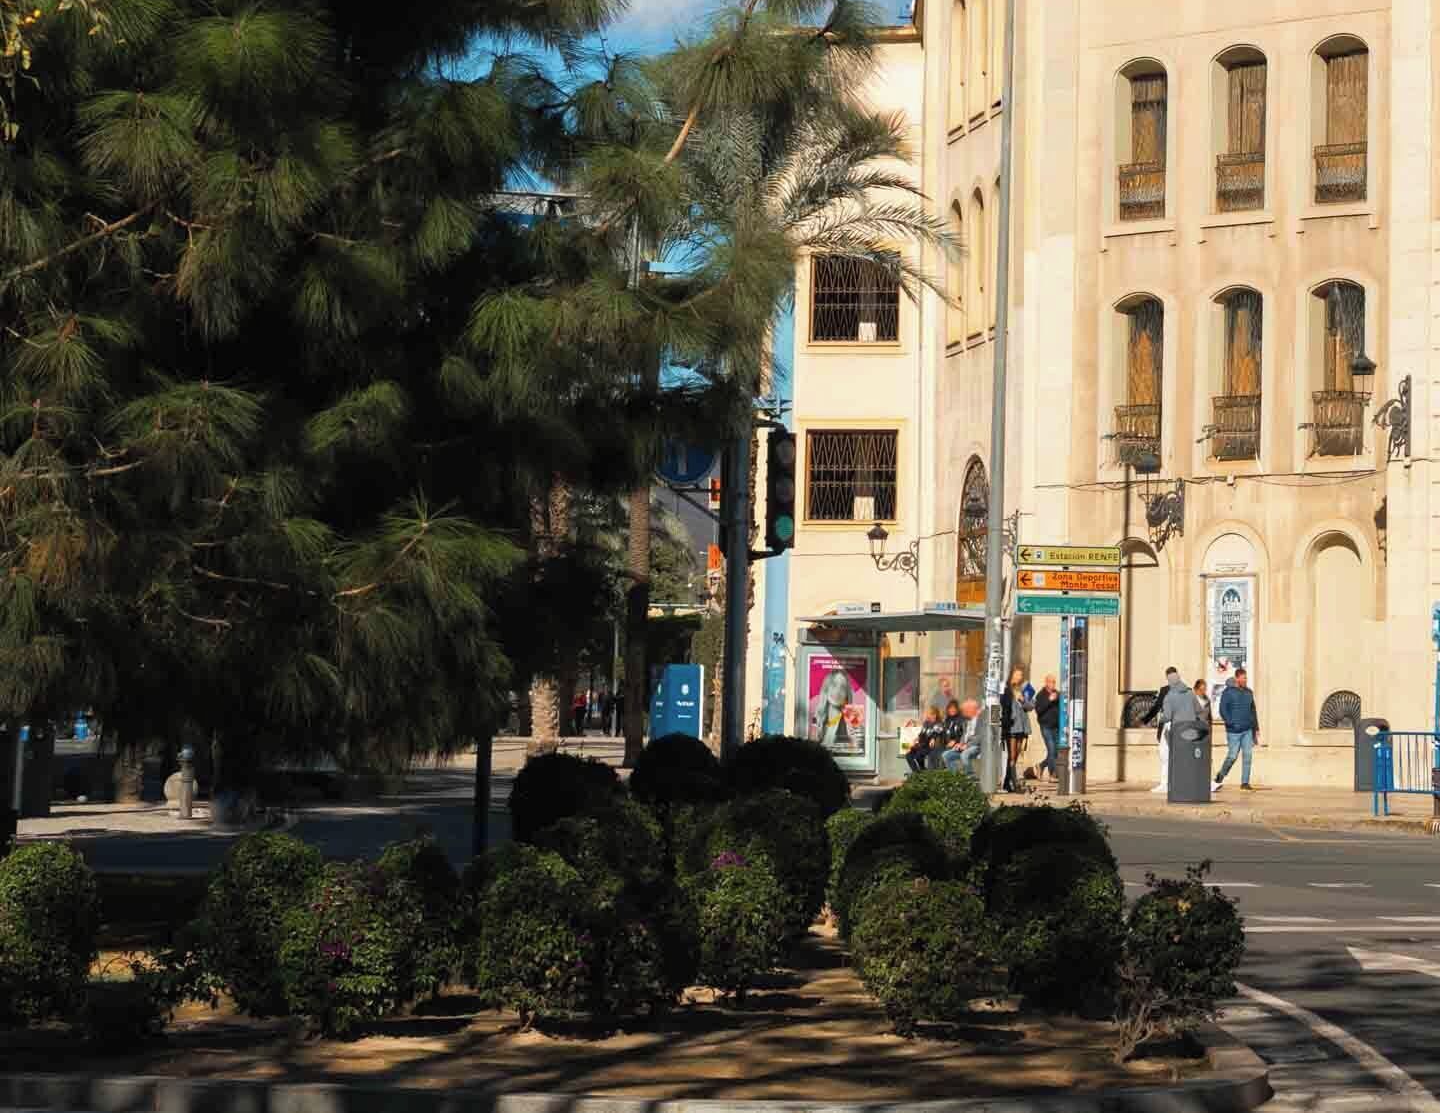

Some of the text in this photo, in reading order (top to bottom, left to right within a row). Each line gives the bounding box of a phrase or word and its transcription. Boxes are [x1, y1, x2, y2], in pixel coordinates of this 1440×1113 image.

[1049, 550, 1119, 561] Estación RENFE
[1076, 573, 1118, 583] Deportiva
[1059, 581, 1088, 589] Monte
